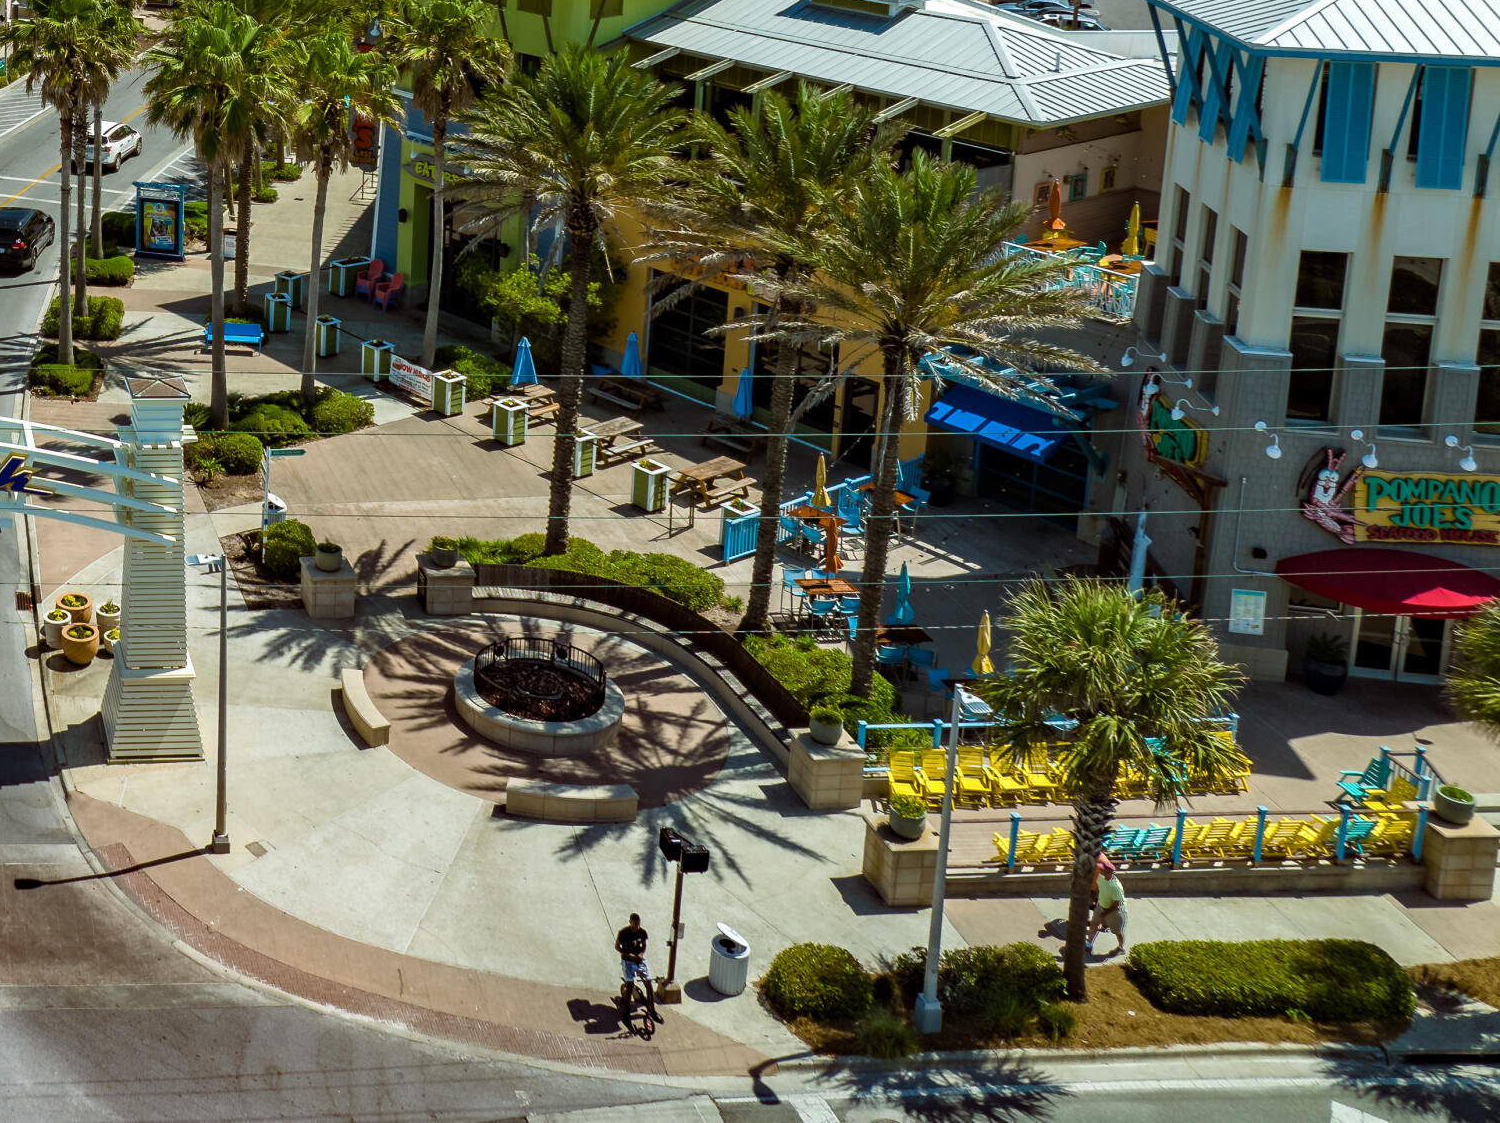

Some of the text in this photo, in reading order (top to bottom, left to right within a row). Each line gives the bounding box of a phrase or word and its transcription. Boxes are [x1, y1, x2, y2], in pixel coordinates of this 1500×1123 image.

[1364, 477, 1500, 514] POMPANO
[1366, 524, 1499, 544] SEAFOOD HOUSE
